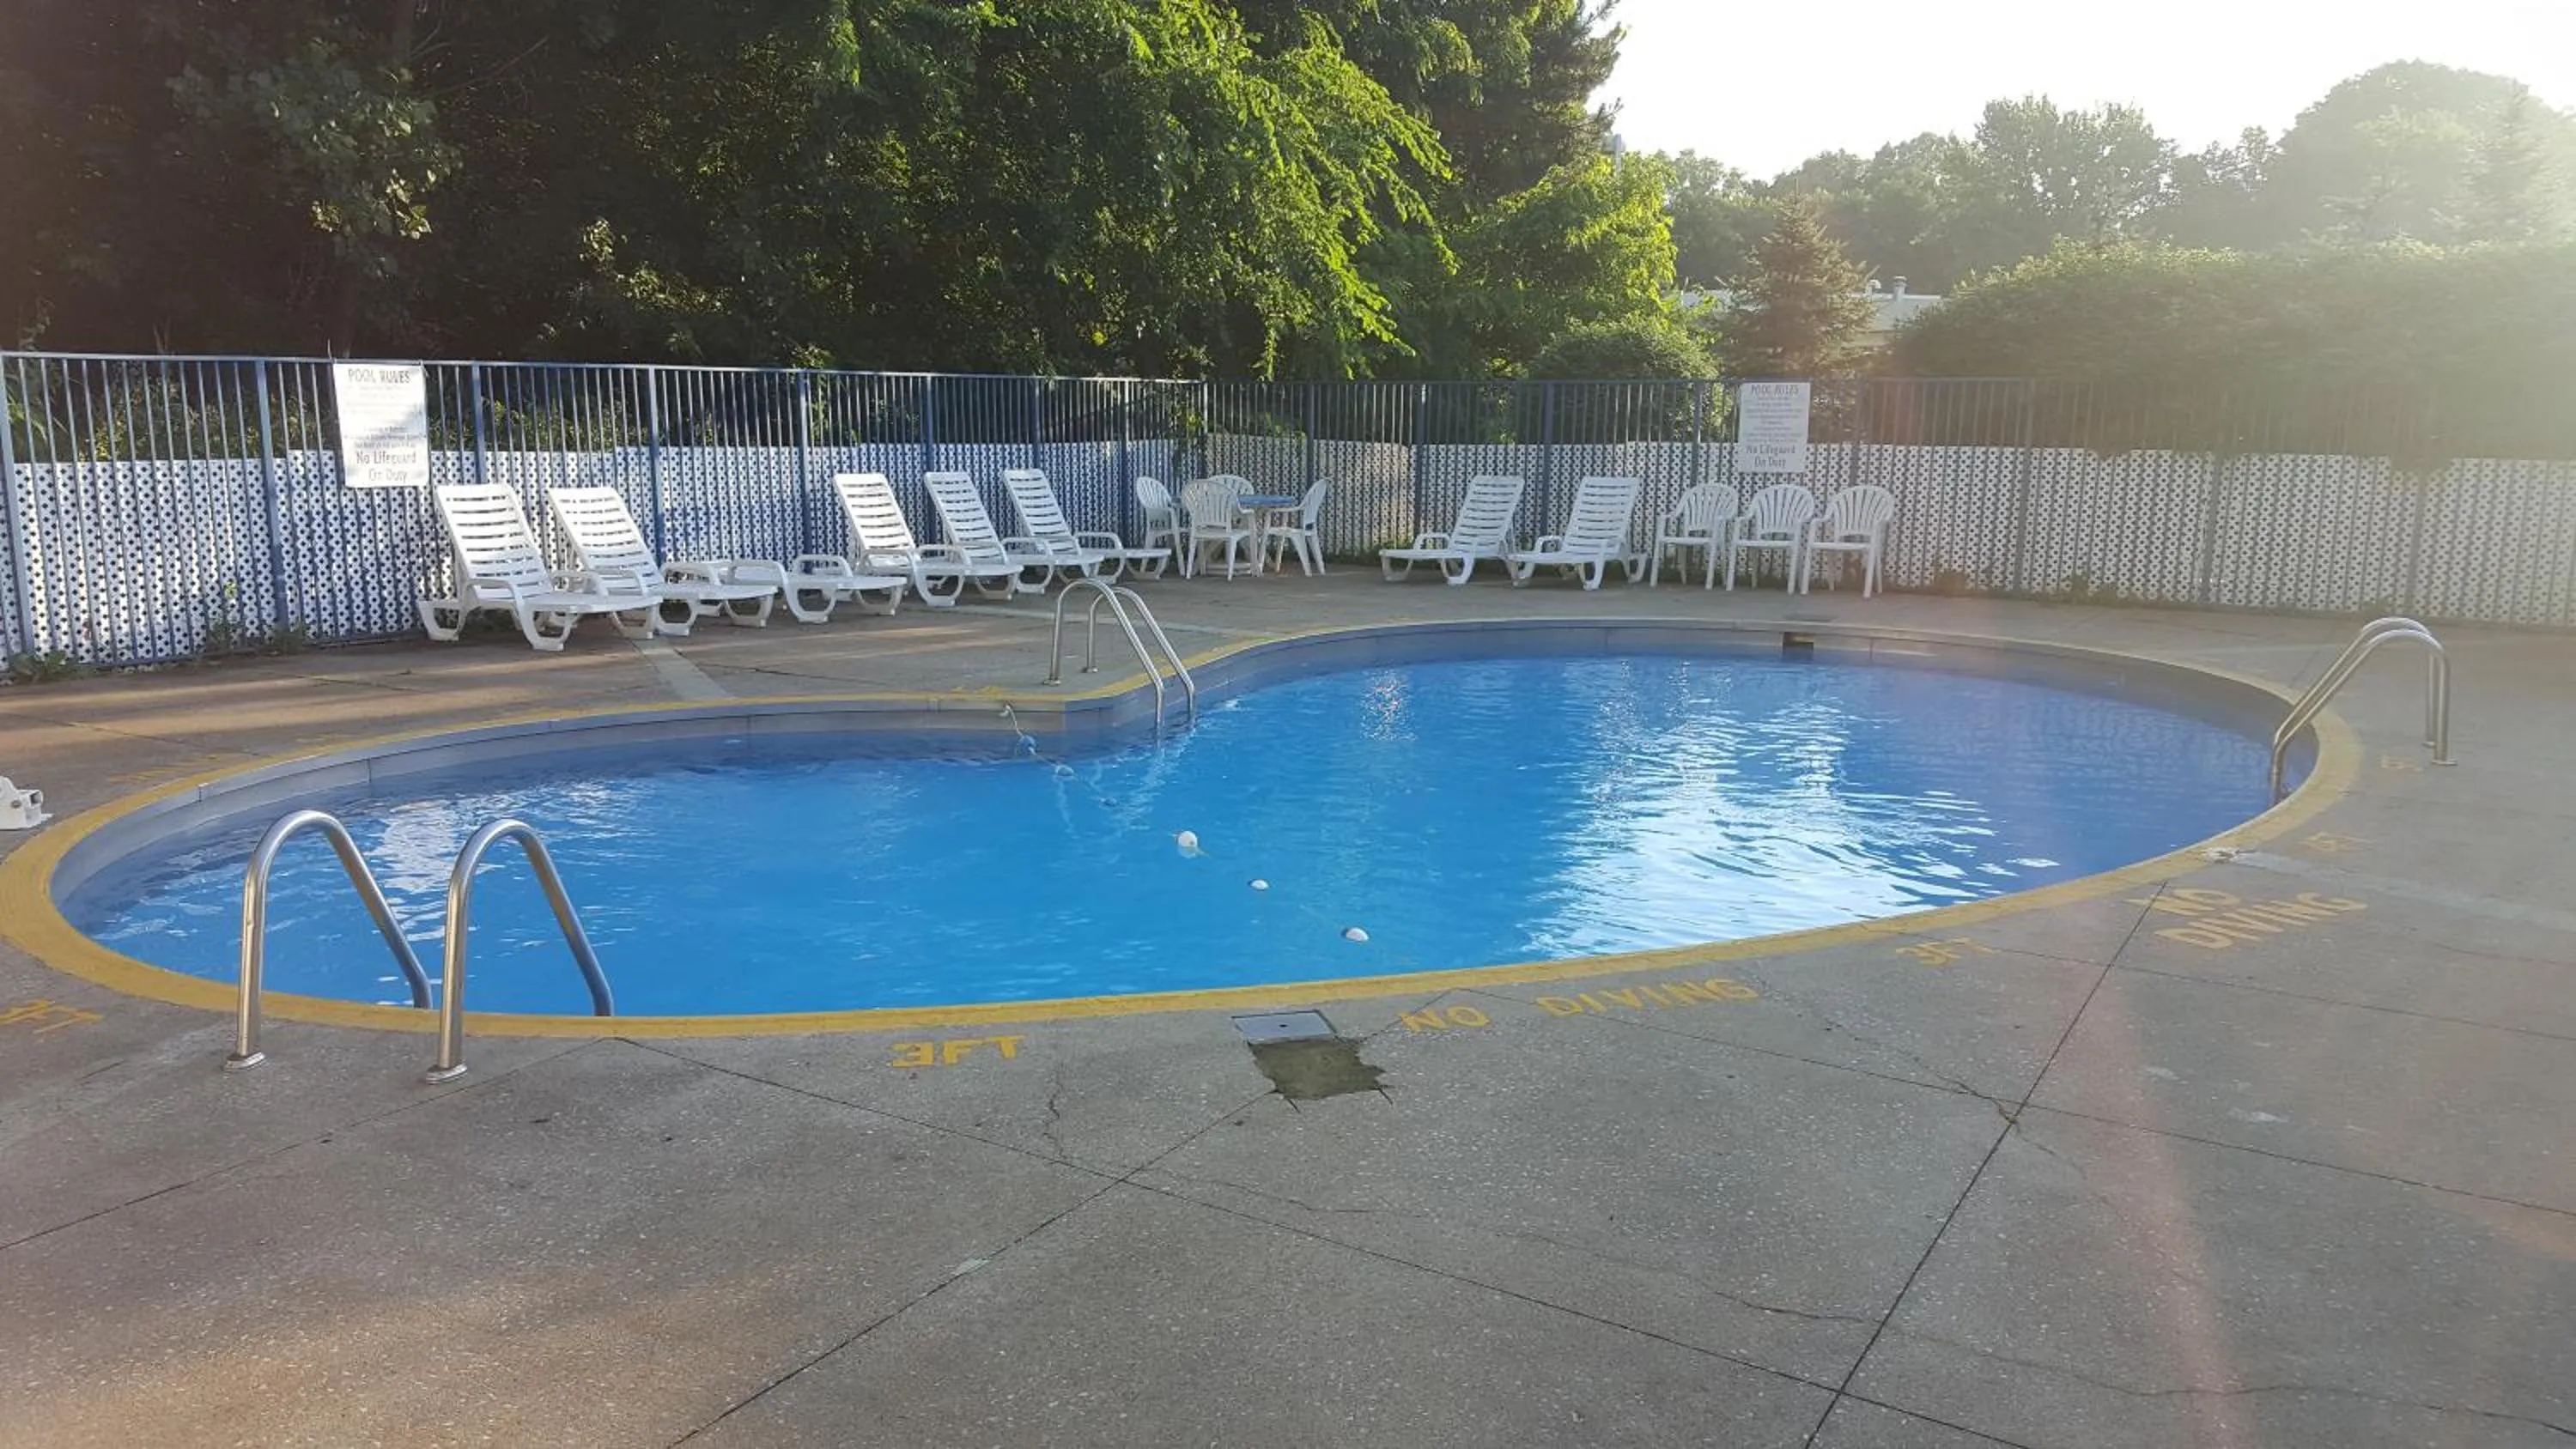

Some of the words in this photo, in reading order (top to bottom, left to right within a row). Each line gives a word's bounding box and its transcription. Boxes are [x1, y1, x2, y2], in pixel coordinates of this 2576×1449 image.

[348, 368, 376, 383] POOL
[356, 451, 370, 464] No
[374, 451, 416, 465] Lifeguard
[2129, 888, 2243, 916] NO
[2154, 891, 2367, 949] DIVING
[1400, 1005, 1491, 1034] NO
[1535, 978, 1758, 1016] DIVING
[890, 1034, 1026, 1069] 3FT
